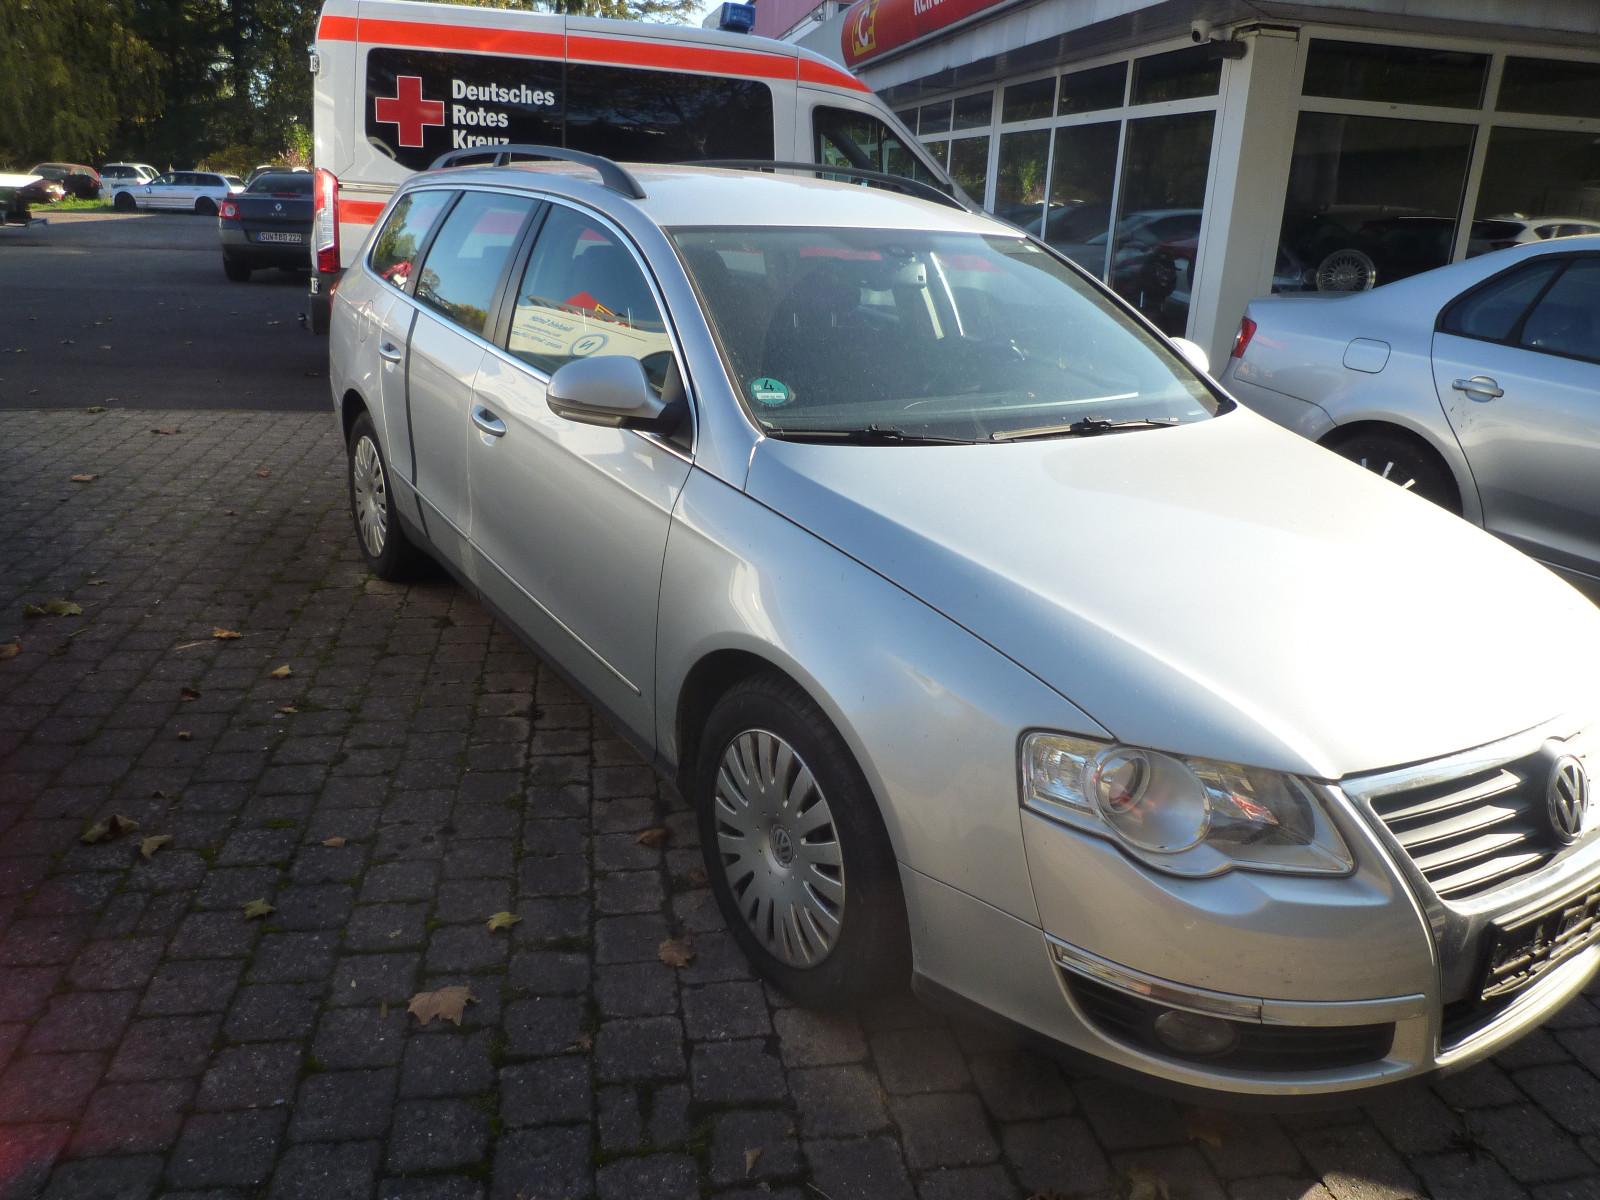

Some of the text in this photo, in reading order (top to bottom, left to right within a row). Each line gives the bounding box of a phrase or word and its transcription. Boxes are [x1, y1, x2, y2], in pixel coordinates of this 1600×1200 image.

[452, 79, 555, 106] Deutsches
[452, 104, 509, 128] Rotes
[763, 379, 775, 392] 4
